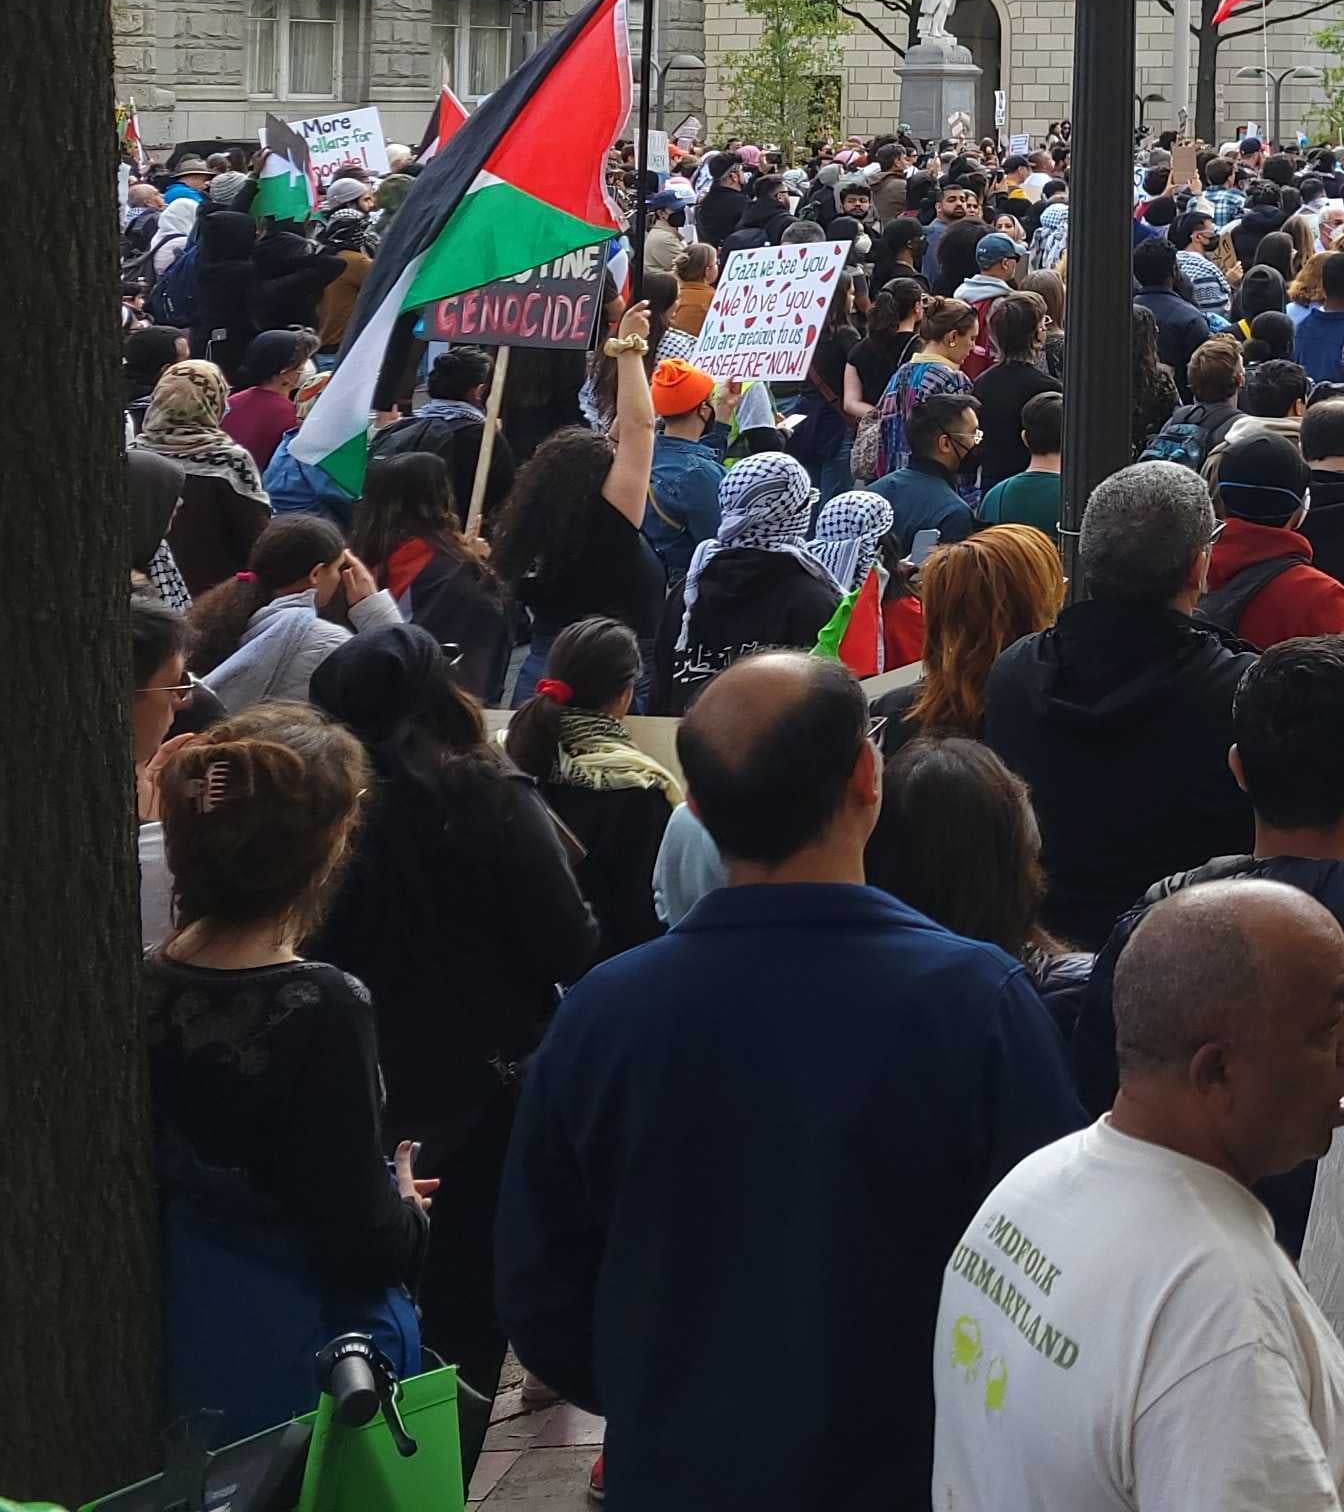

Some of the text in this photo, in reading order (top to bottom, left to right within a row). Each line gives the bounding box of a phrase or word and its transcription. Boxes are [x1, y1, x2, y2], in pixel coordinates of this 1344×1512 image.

[303, 117, 351, 138] More
[311, 128, 373, 153] ollars for
[728, 252, 828, 281] Gaza we see you
[436, 291, 593, 341] GENOCIDE
[720, 286, 741, 317] We
[743, 285, 777, 314] love
[702, 321, 718, 352] You
[718, 334, 737, 349] are
[734, 328, 777, 354] precious
[777, 322, 789, 344] to
[766, 350, 806, 376] NOW!
[953, 1245, 1080, 1370] URMARYLAND
